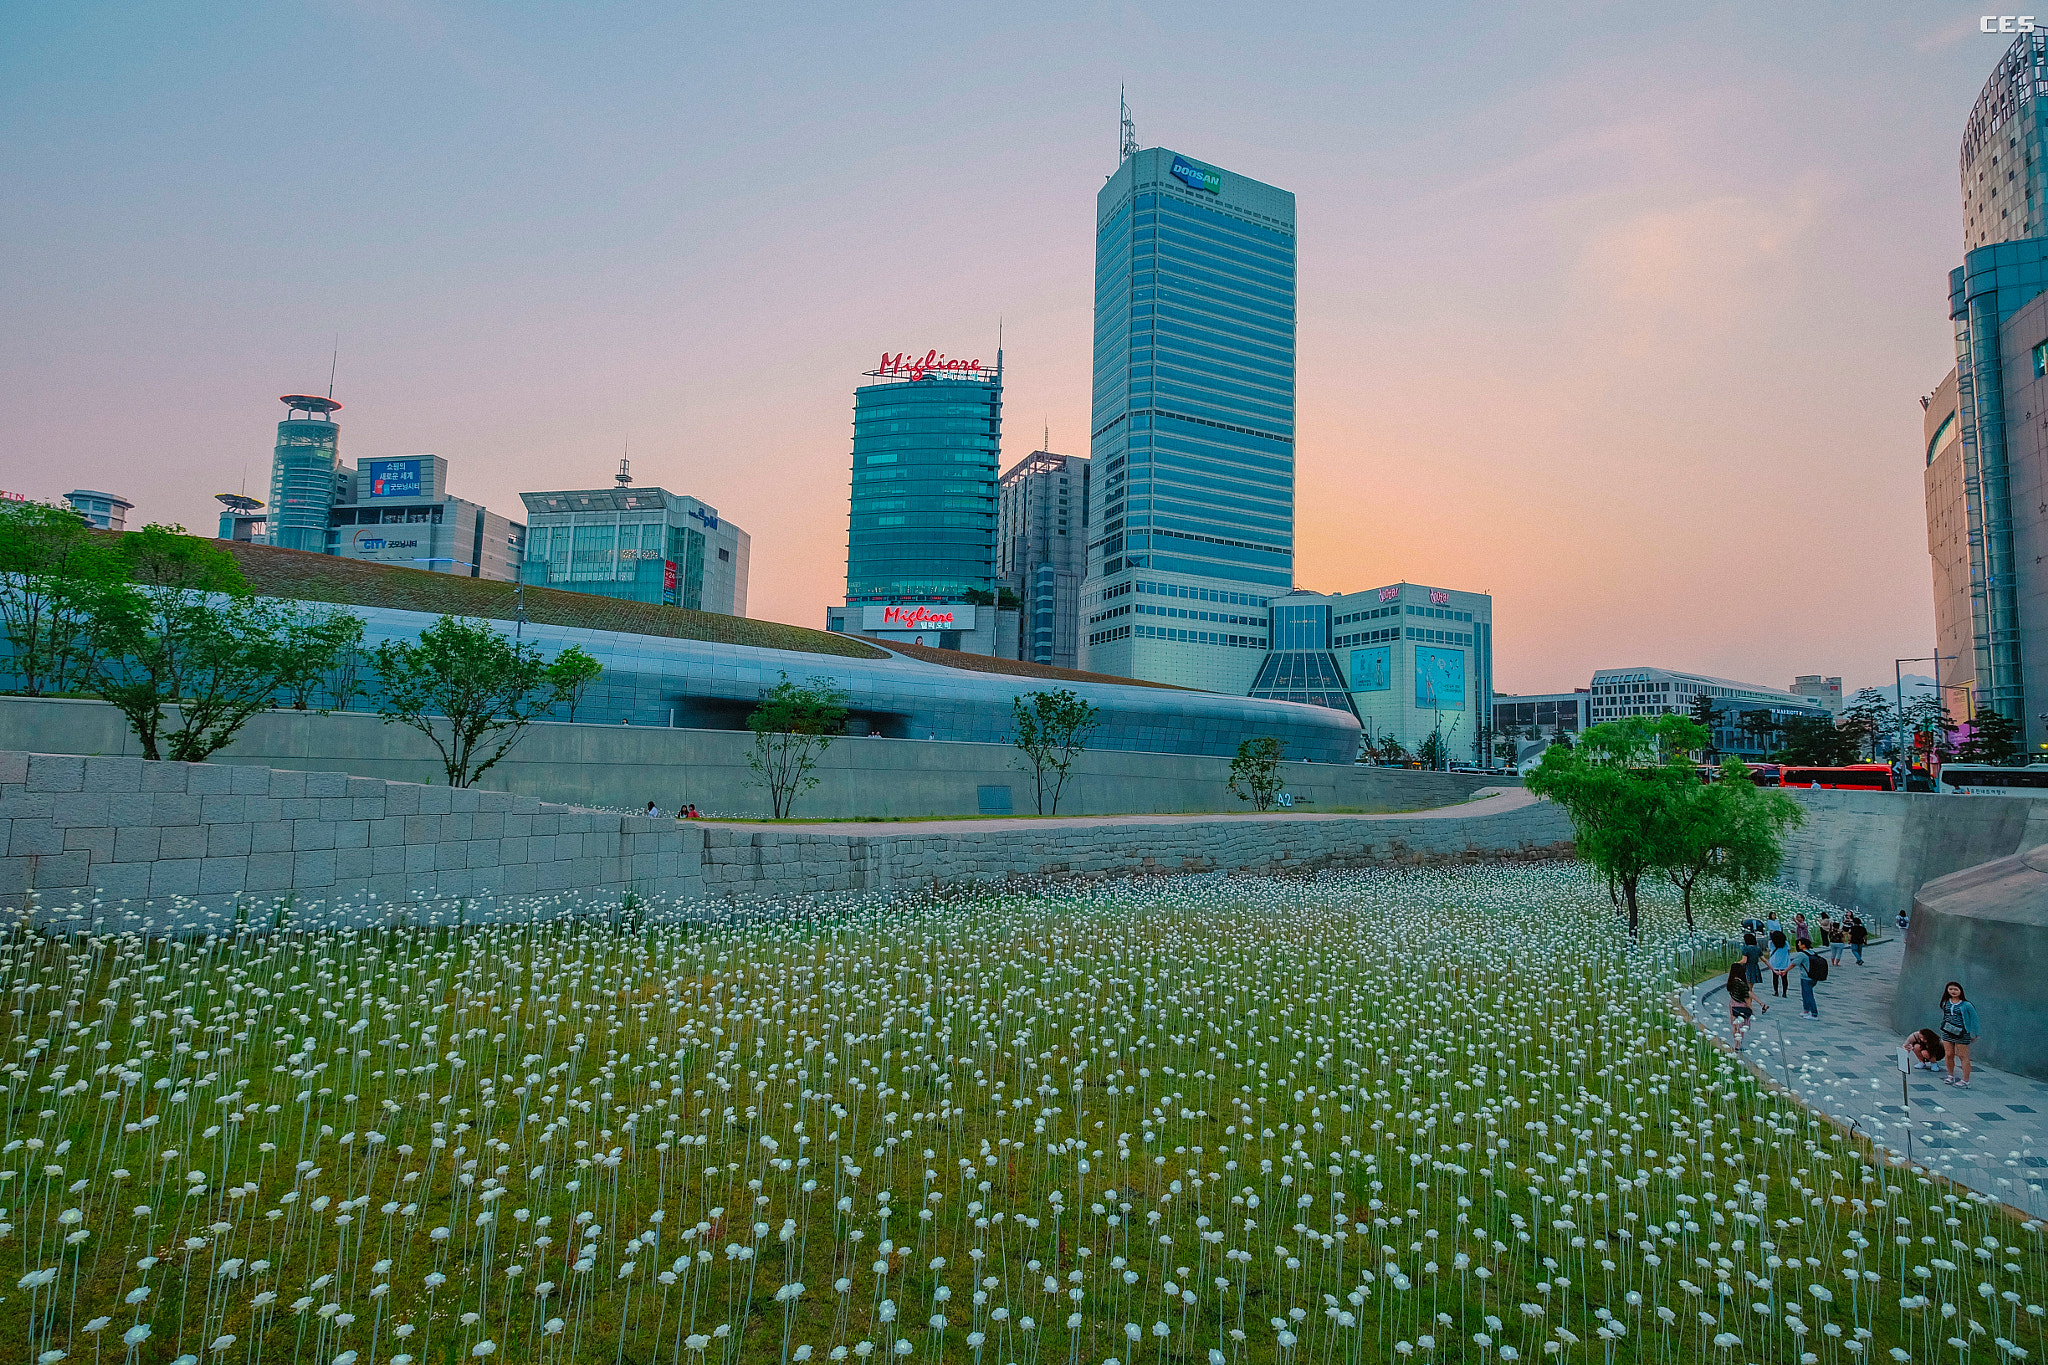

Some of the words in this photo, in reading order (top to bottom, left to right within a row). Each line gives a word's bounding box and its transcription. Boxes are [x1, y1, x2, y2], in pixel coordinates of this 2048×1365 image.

[1173, 164, 1219, 185] DOOSAN
[879, 349, 981, 381] Migliore
[386, 462, 405, 470] 쇼핑의
[380, 472, 399, 480] 새로운
[390, 482, 420, 491] 굿모닝시티
[363, 540, 387, 549] CITY
[388, 540, 417, 548] 굿모닝시티
[883, 606, 954, 628] Migliore
[1277, 792, 1292, 807] A2
